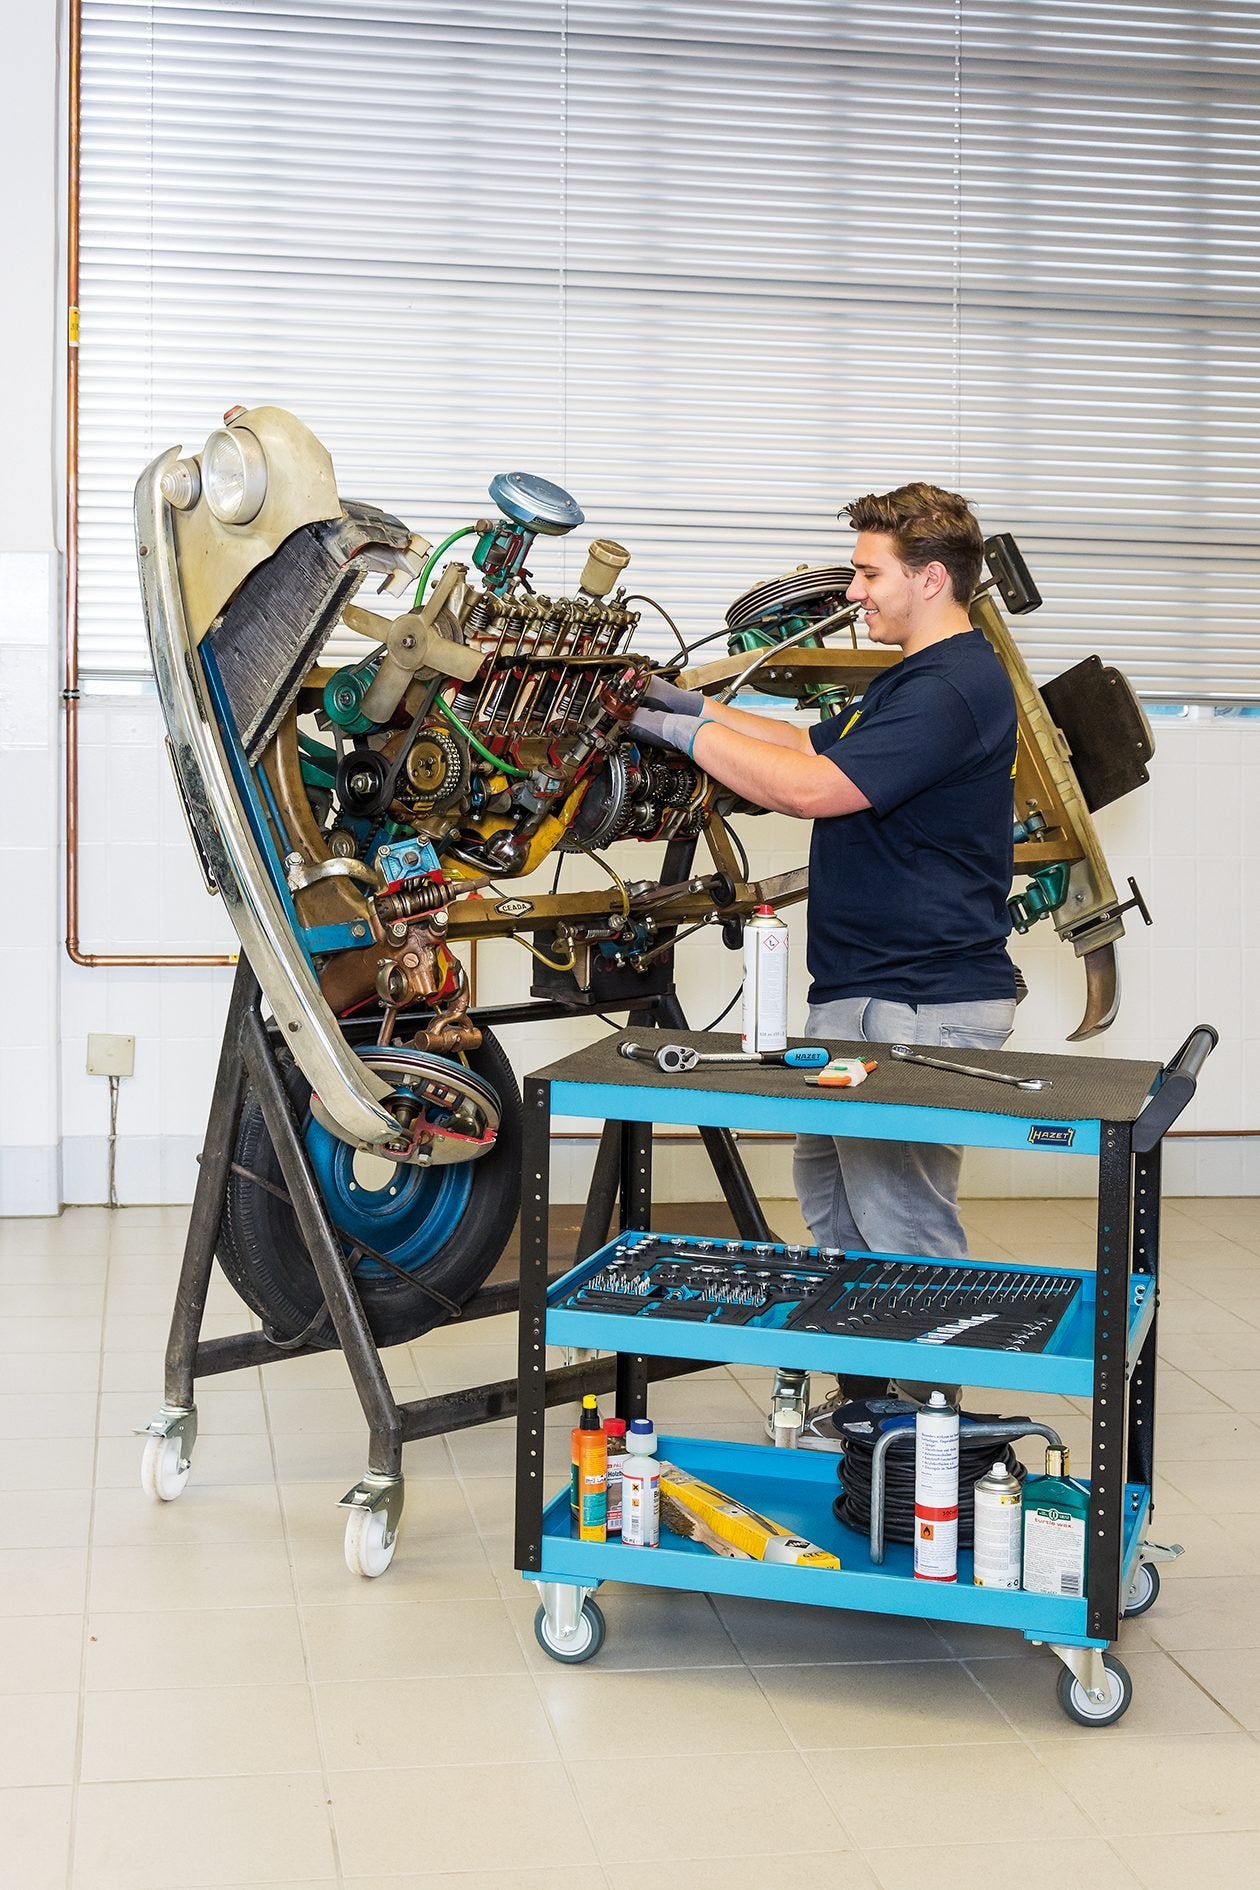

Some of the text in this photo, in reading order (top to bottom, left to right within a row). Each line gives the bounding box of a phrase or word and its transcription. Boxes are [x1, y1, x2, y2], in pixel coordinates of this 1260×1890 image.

[502, 903, 527, 912] CEADA
[795, 1053, 821, 1061] HAZET
[1033, 1130, 1070, 1140] HAZET
[1034, 1517, 1056, 1527] turtle
